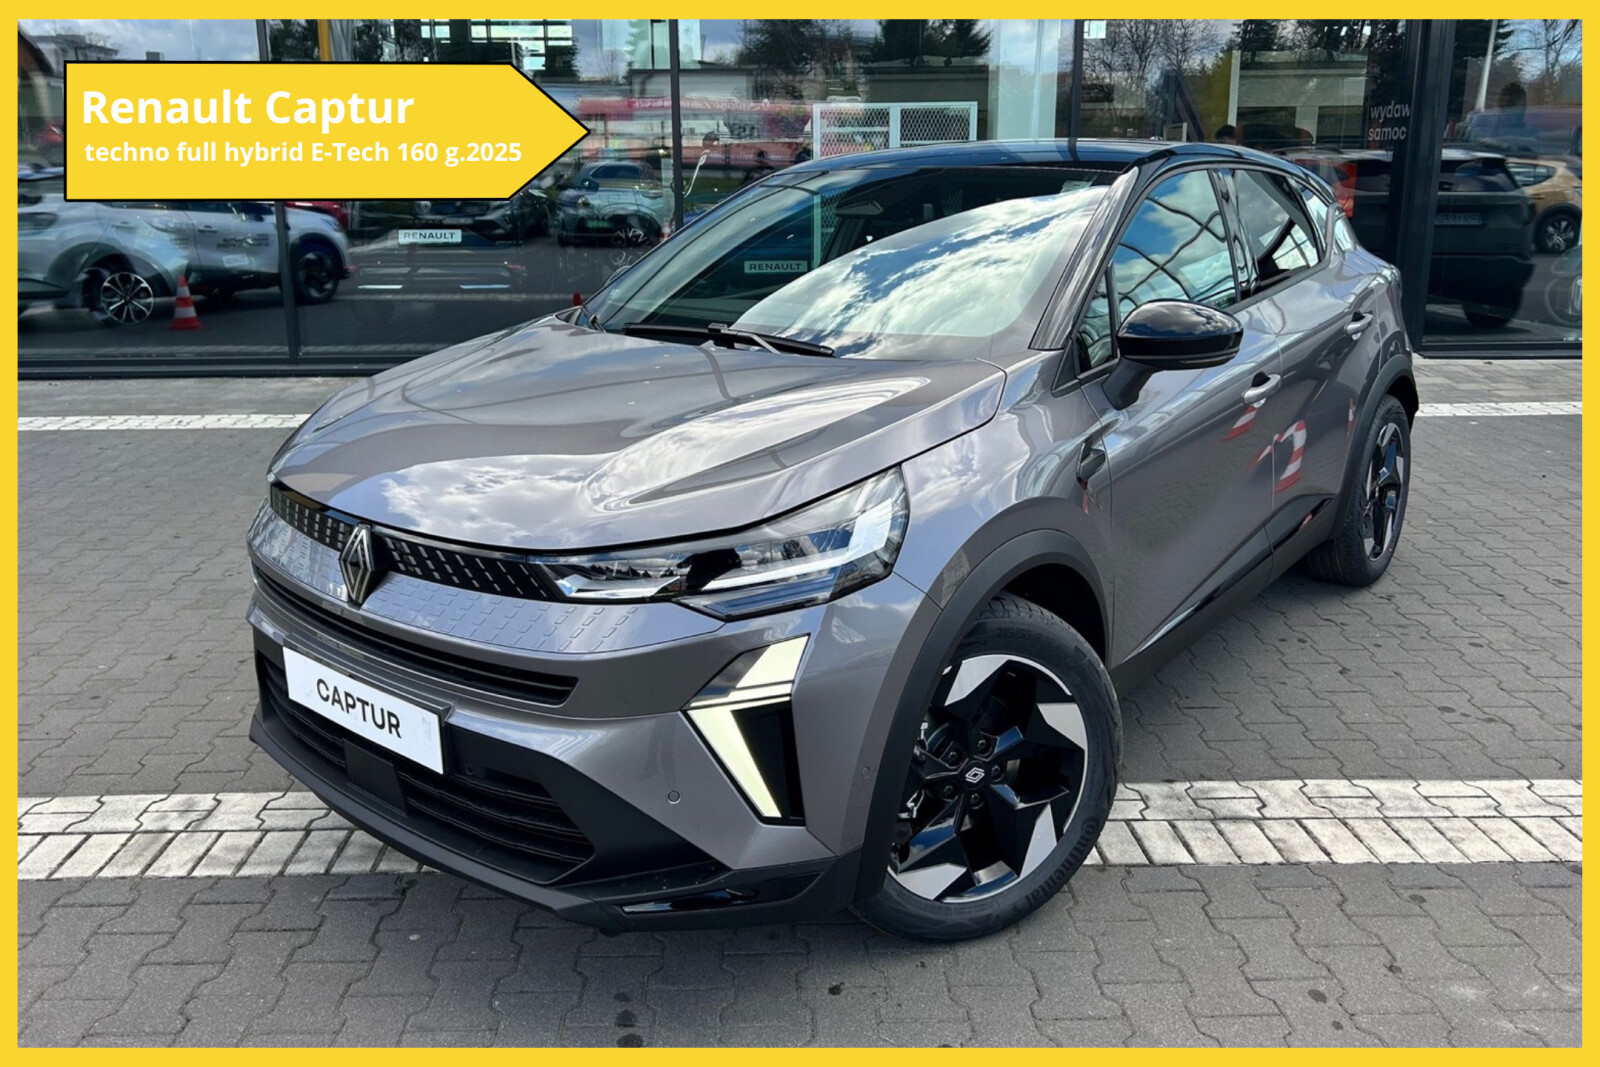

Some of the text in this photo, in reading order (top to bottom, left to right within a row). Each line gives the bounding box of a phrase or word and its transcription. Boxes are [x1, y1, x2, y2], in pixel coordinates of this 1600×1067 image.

[1368, 126, 1407, 141] samoc
[403, 231, 456, 240] RENAULT
[748, 263, 802, 271] RENAULT
[316, 678, 402, 739] CAPTUR
[1025, 815, 1101, 909] Continental
